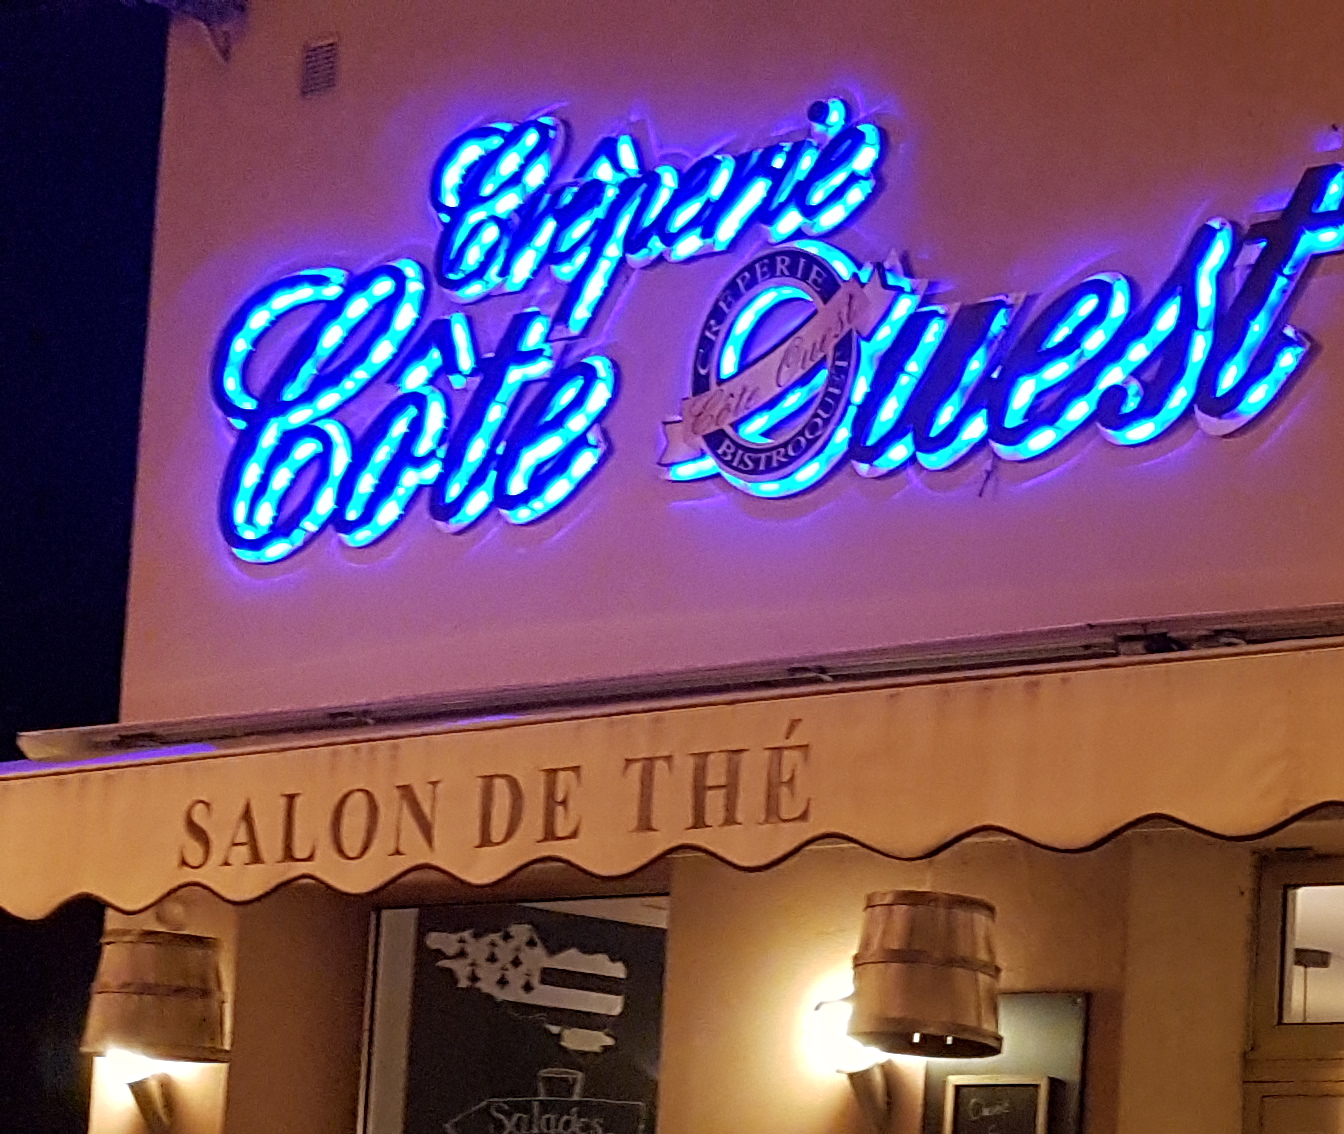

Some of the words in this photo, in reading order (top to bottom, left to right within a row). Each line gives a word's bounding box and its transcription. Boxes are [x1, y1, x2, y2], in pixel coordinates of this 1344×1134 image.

[432, 97, 882, 340] Crêperie
[697, 256, 826, 376] CREPERIE
[213, 256, 619, 564] Côte
[717, 360, 848, 471] BISTROQUET
[178, 781, 441, 869] SALON
[474, 766, 583, 849] DE
[624, 719, 812, 834] THÉ
